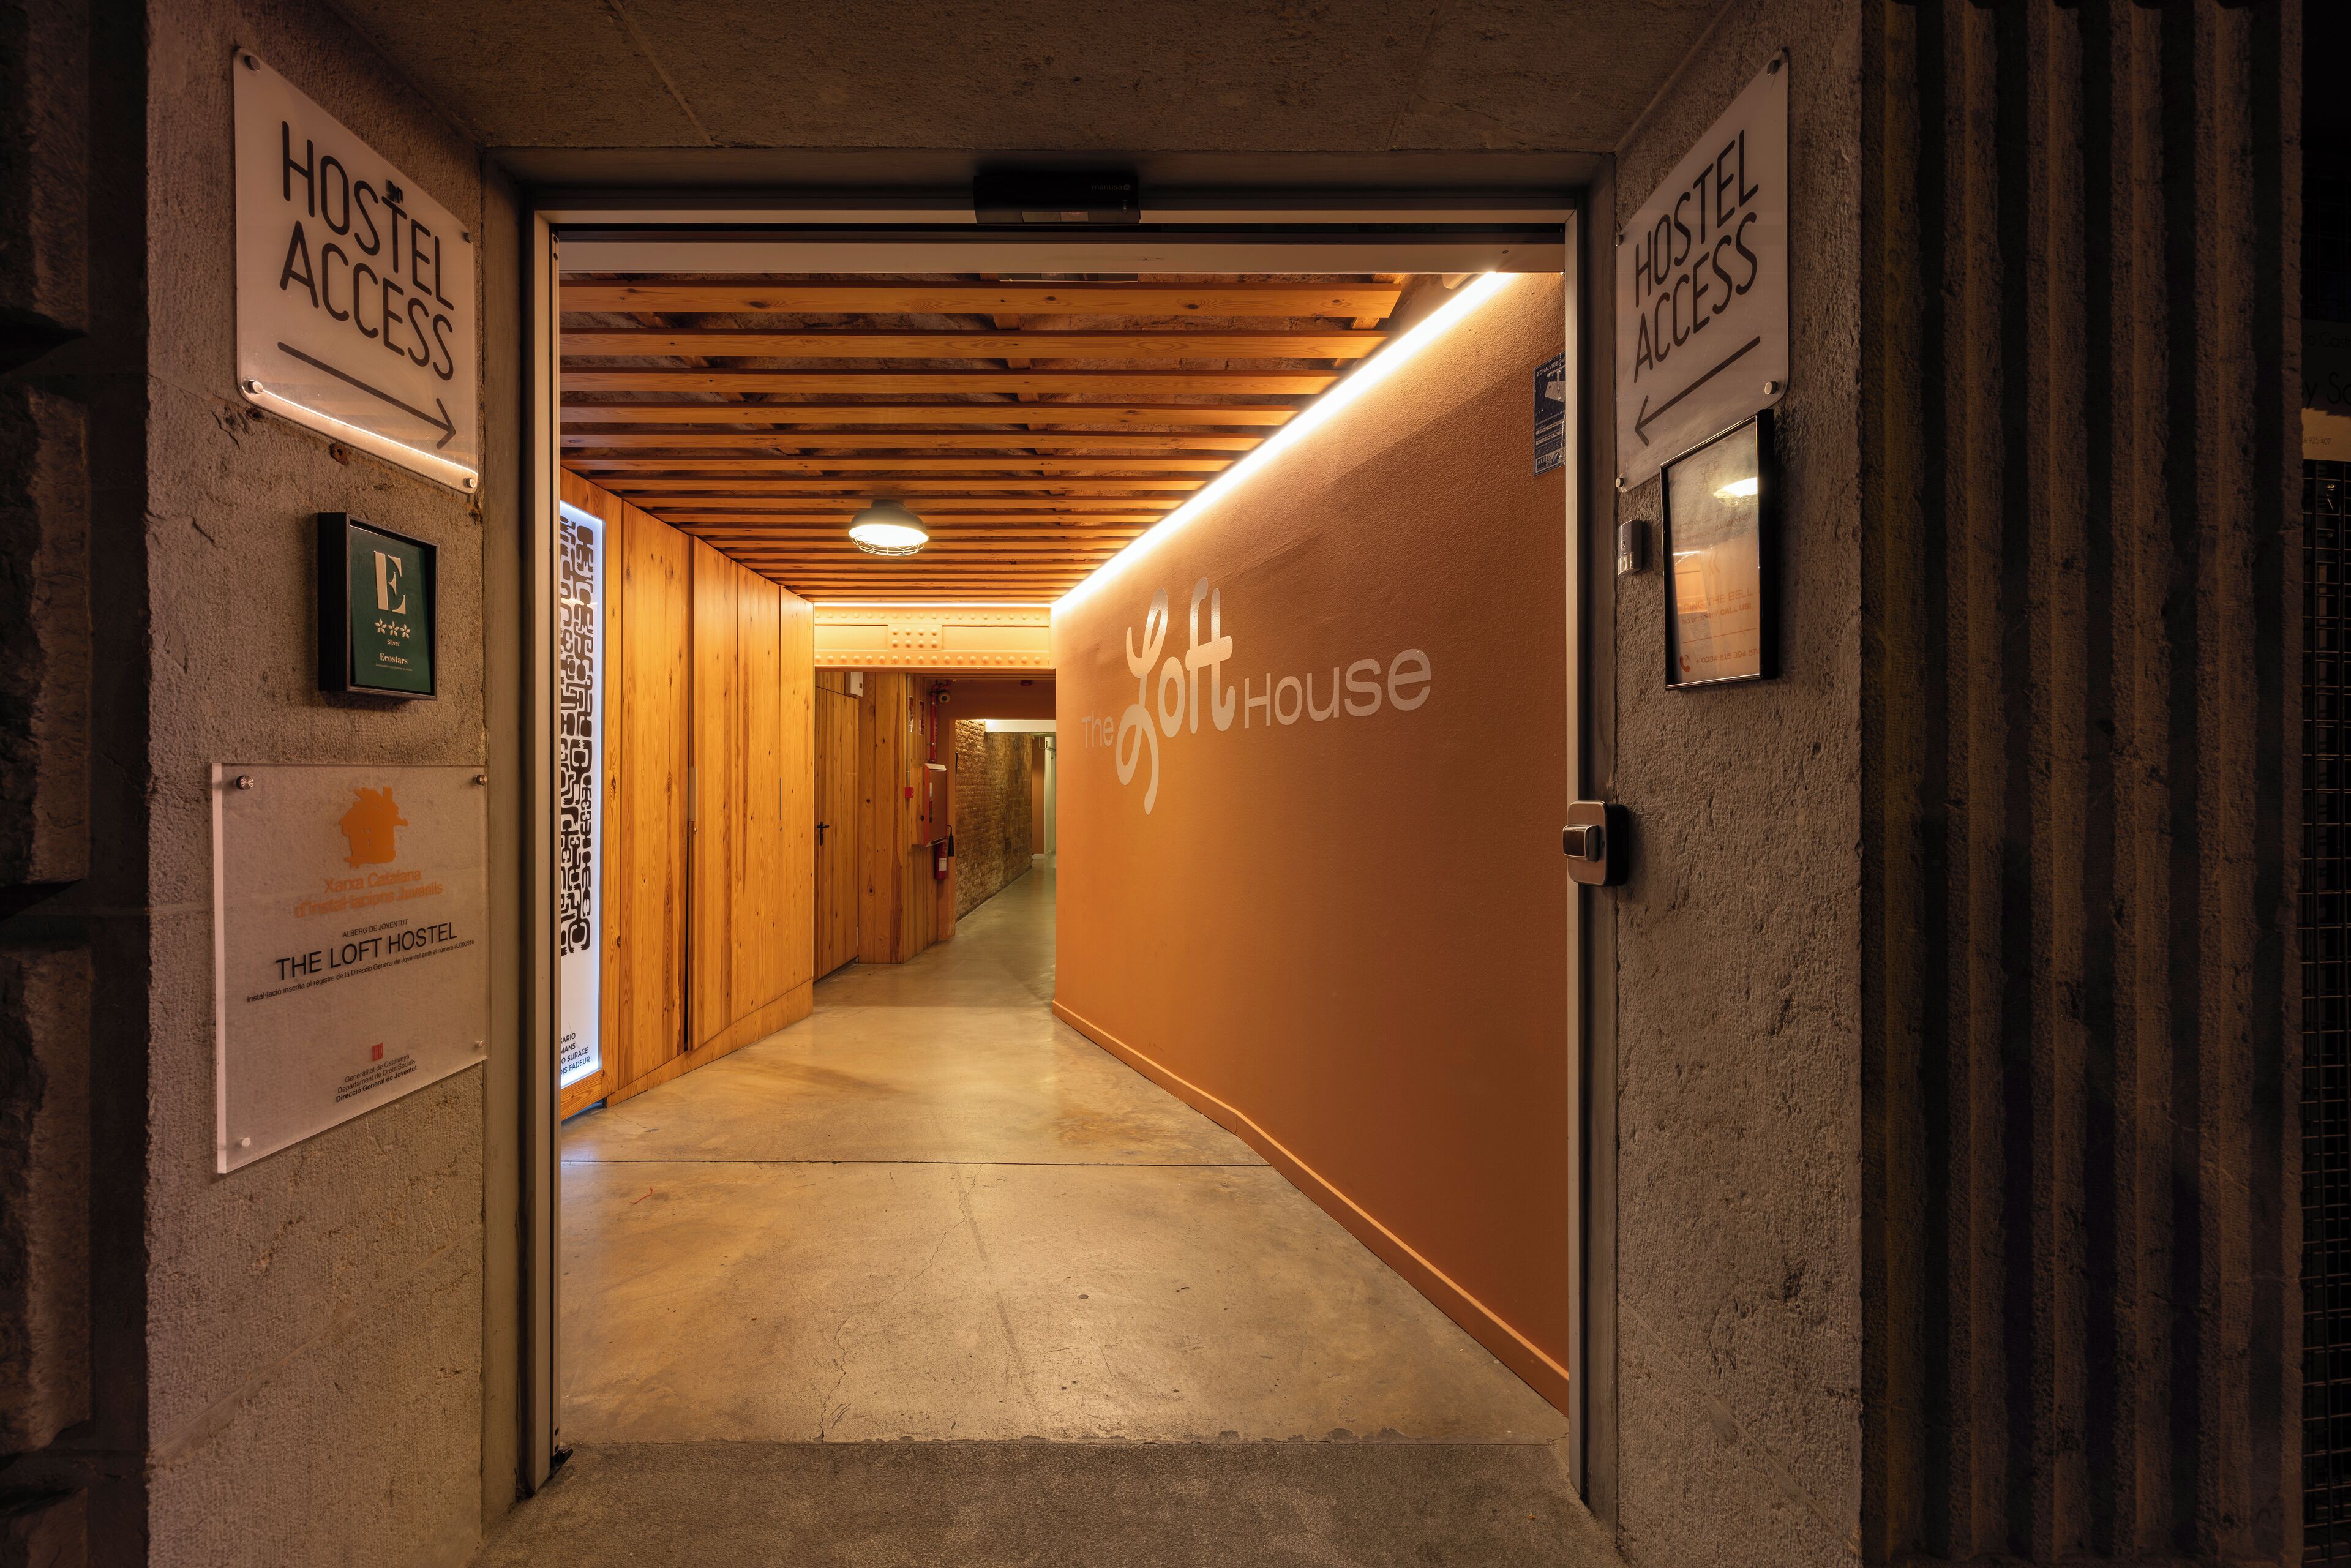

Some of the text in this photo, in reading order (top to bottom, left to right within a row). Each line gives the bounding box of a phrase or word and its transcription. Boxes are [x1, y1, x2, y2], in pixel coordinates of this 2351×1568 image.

[282, 121, 454, 311] HOSTEL
[1635, 129, 1759, 308] HOSTEL
[279, 220, 454, 381] ACCESS
[1633, 211, 1758, 384] ACCESS
[1537, 367, 1549, 377] ZONA
[2302, 381, 2318, 409] y
[373, 550, 406, 615] E
[1684, 587, 1753, 613] RING THE BELL
[1720, 606, 1738, 616] CALL
[1739, 602, 1751, 611] US!
[380, 652, 408, 665] Ecostars
[1081, 710, 1114, 749] The
[1116, 577, 1235, 815] Loft
[324, 869, 422, 894] Xarxa Catalana
[397, 881, 443, 901] Juvenils
[342, 926, 368, 938] ALBERG
[378, 918, 408, 931] JOVENTUT
[275, 921, 457, 980] THE LOFT HOSTEL
[283, 983, 305, 993] inscrita
[313, 975, 335, 986] registre
[351, 965, 372, 977] Direcció
[373, 961, 393, 970] General
[401, 953, 421, 963] Joventut
[437, 945, 454, 954] número
[345, 1067, 375, 1083] Generalitat
[384, 1054, 410, 1068] Catalunya
[567, 1047, 588, 1062] SURACE
[569, 1056, 590, 1071] FADEUR
[336, 1088, 361, 1103] Direcció
[362, 1079, 385, 1092] General
[394, 1065, 418, 1079] Joventut
[337, 1076, 373, 1094] Departament
[383, 1067, 397, 1076] Drets
[398, 1059, 416, 1070] Socials
